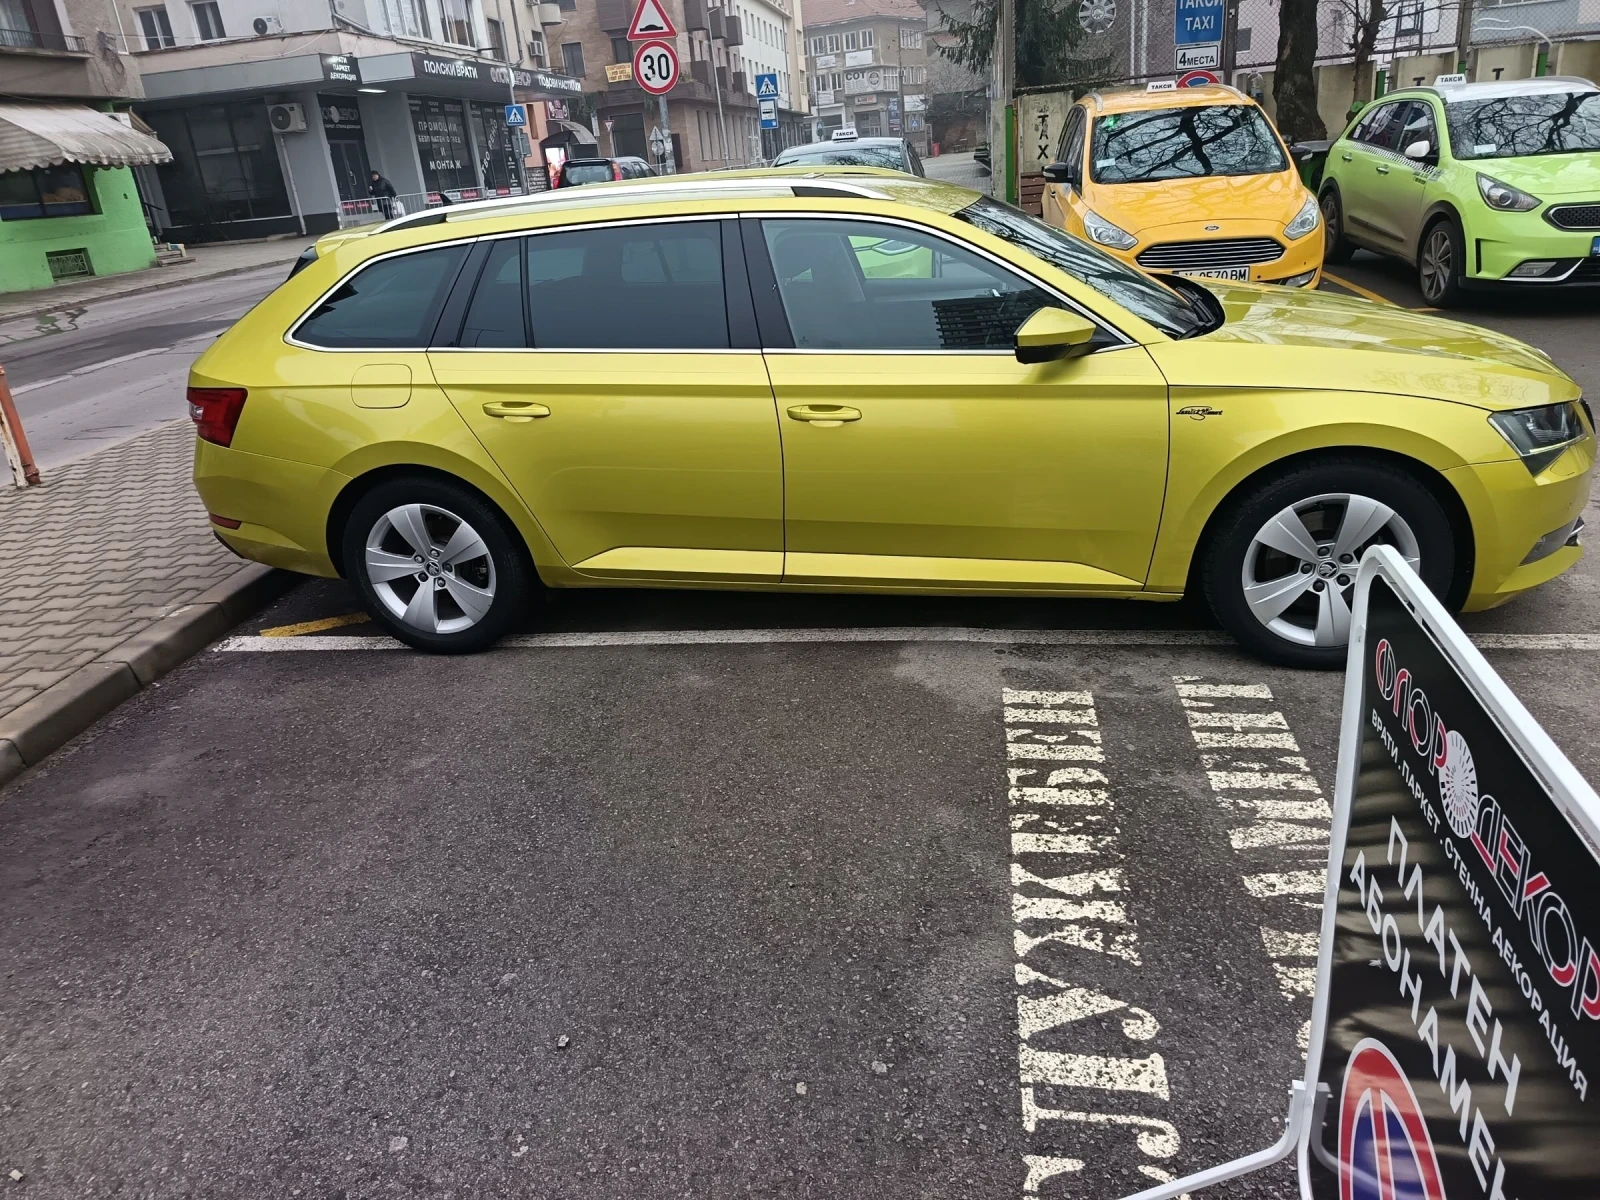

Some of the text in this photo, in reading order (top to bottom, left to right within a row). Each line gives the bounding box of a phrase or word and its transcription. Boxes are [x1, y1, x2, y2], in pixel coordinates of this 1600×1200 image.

[1185, 15, 1215, 31] TAXI
[423, 59, 478, 79] ПОЛСКИ ВРАТИ
[643, 53, 671, 81] 30
[538, 76, 558, 89] ПОДОВИ
[418, 121, 458, 133] ПРОМОЦИИ
[440, 147, 446, 156] И
[429, 159, 462, 171] МОНТАЖ
[1371, 708, 1399, 763] ВРАТИ
[1492, 926, 1588, 1102] ДЕКОРАЦИЯ
[1387, 815, 1521, 1117] ПЛАТЕН
